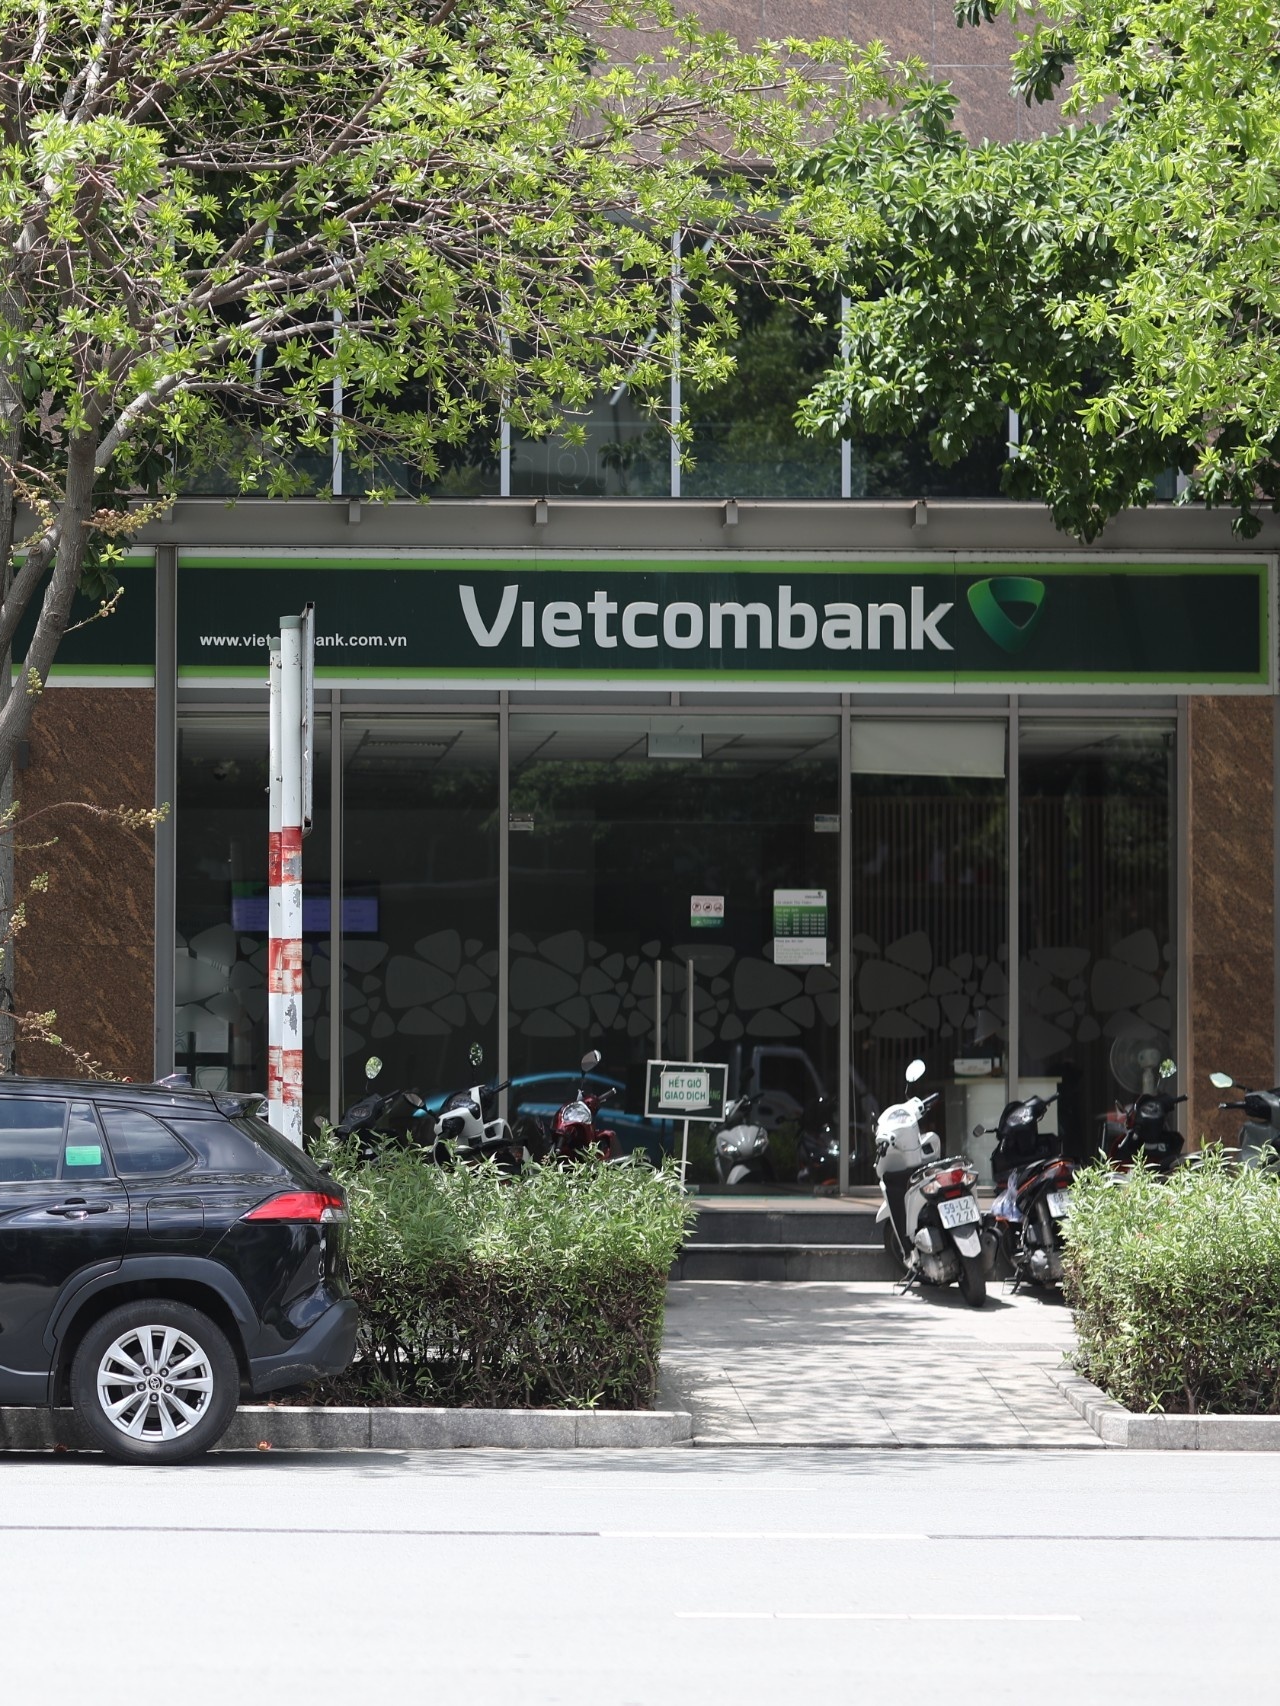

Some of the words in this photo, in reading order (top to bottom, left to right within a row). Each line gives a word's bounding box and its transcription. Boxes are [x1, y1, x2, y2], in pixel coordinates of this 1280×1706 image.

[459, 584, 954, 650] Vietcombank
[199, 633, 407, 647] www.vietank.com.vn
[668, 1076, 685, 1089] HẾT
[664, 1090, 684, 1100] GIAO
[686, 1091, 706, 1102] DỊCH
